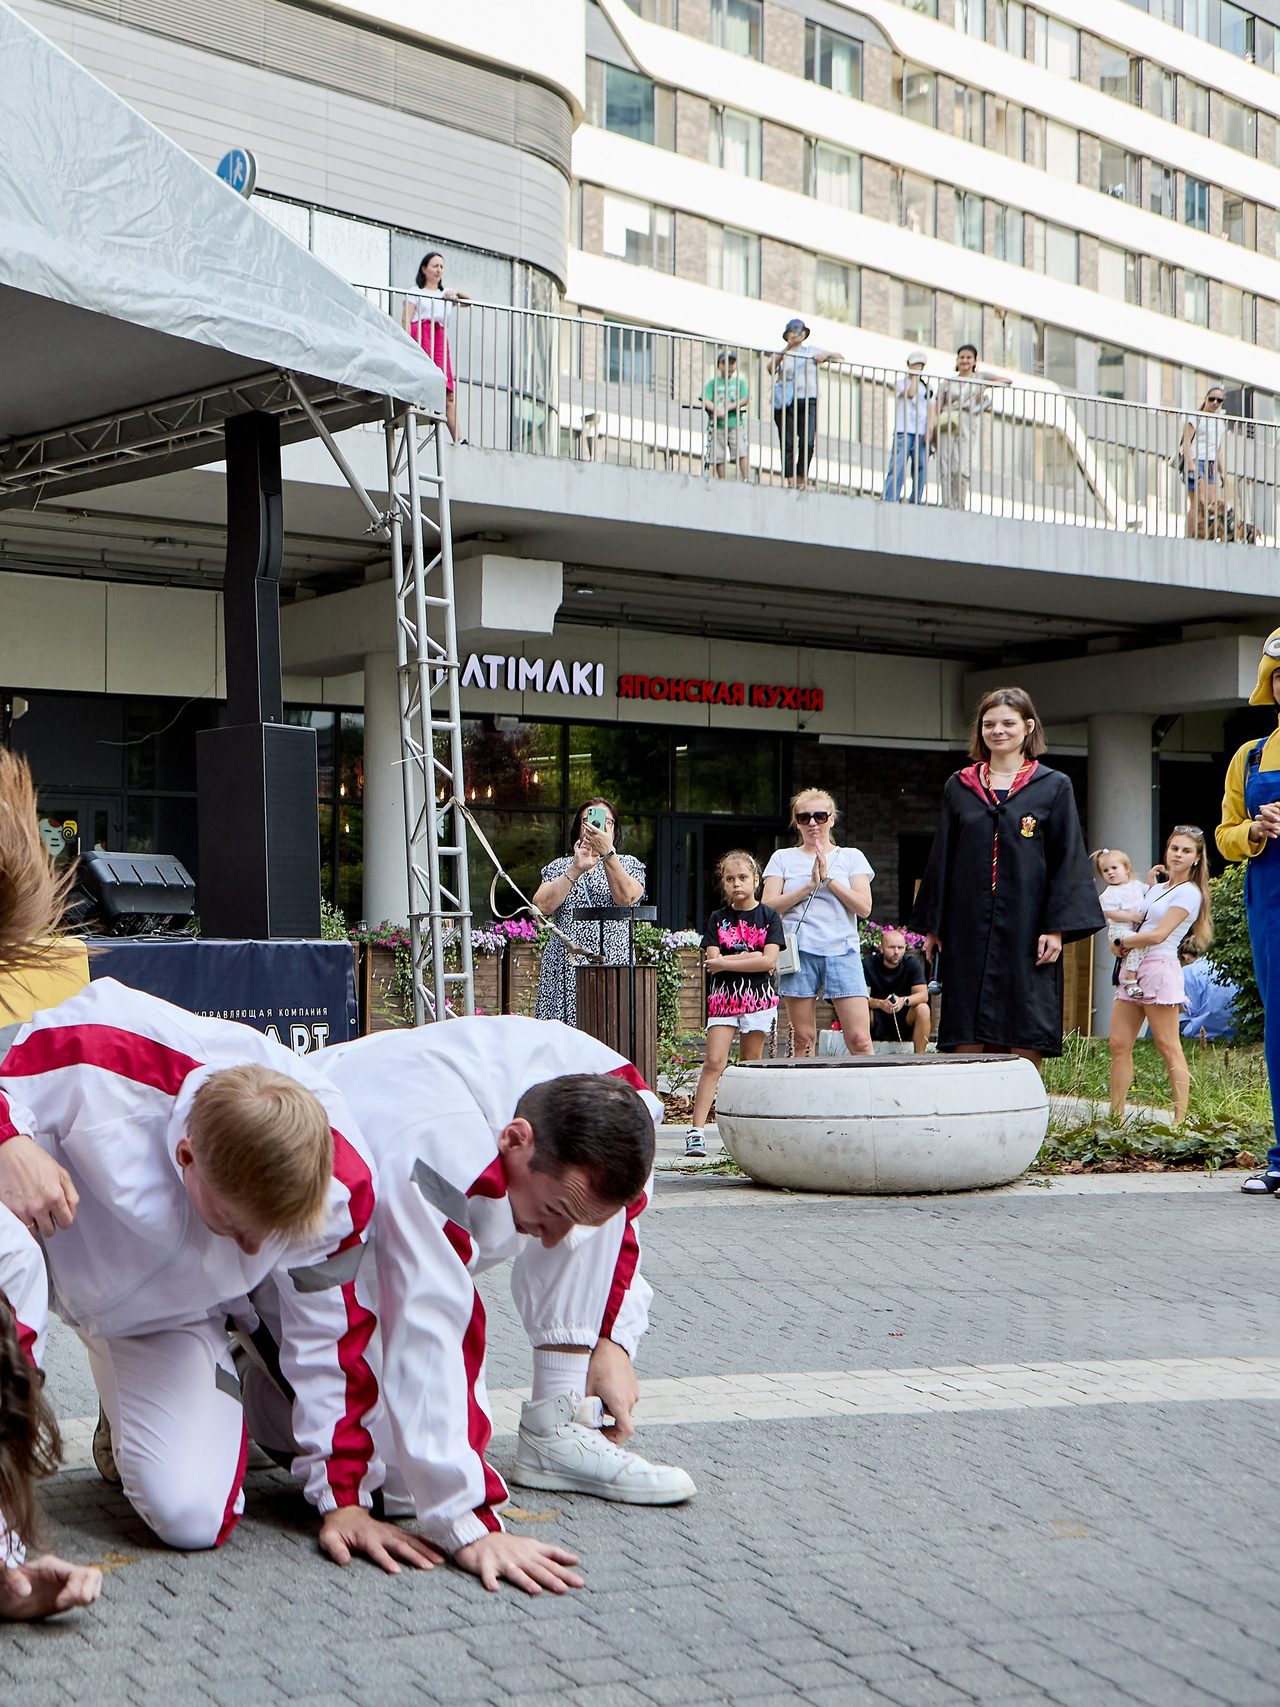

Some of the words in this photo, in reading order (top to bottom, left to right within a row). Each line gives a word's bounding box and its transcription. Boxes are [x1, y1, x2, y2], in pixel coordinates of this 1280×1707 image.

[619, 674, 744, 706] ЯПОНСКАЯ
[750, 685, 823, 711] КУХНЯ
[279, 1008, 328, 1017] КОМПАНИЯ
